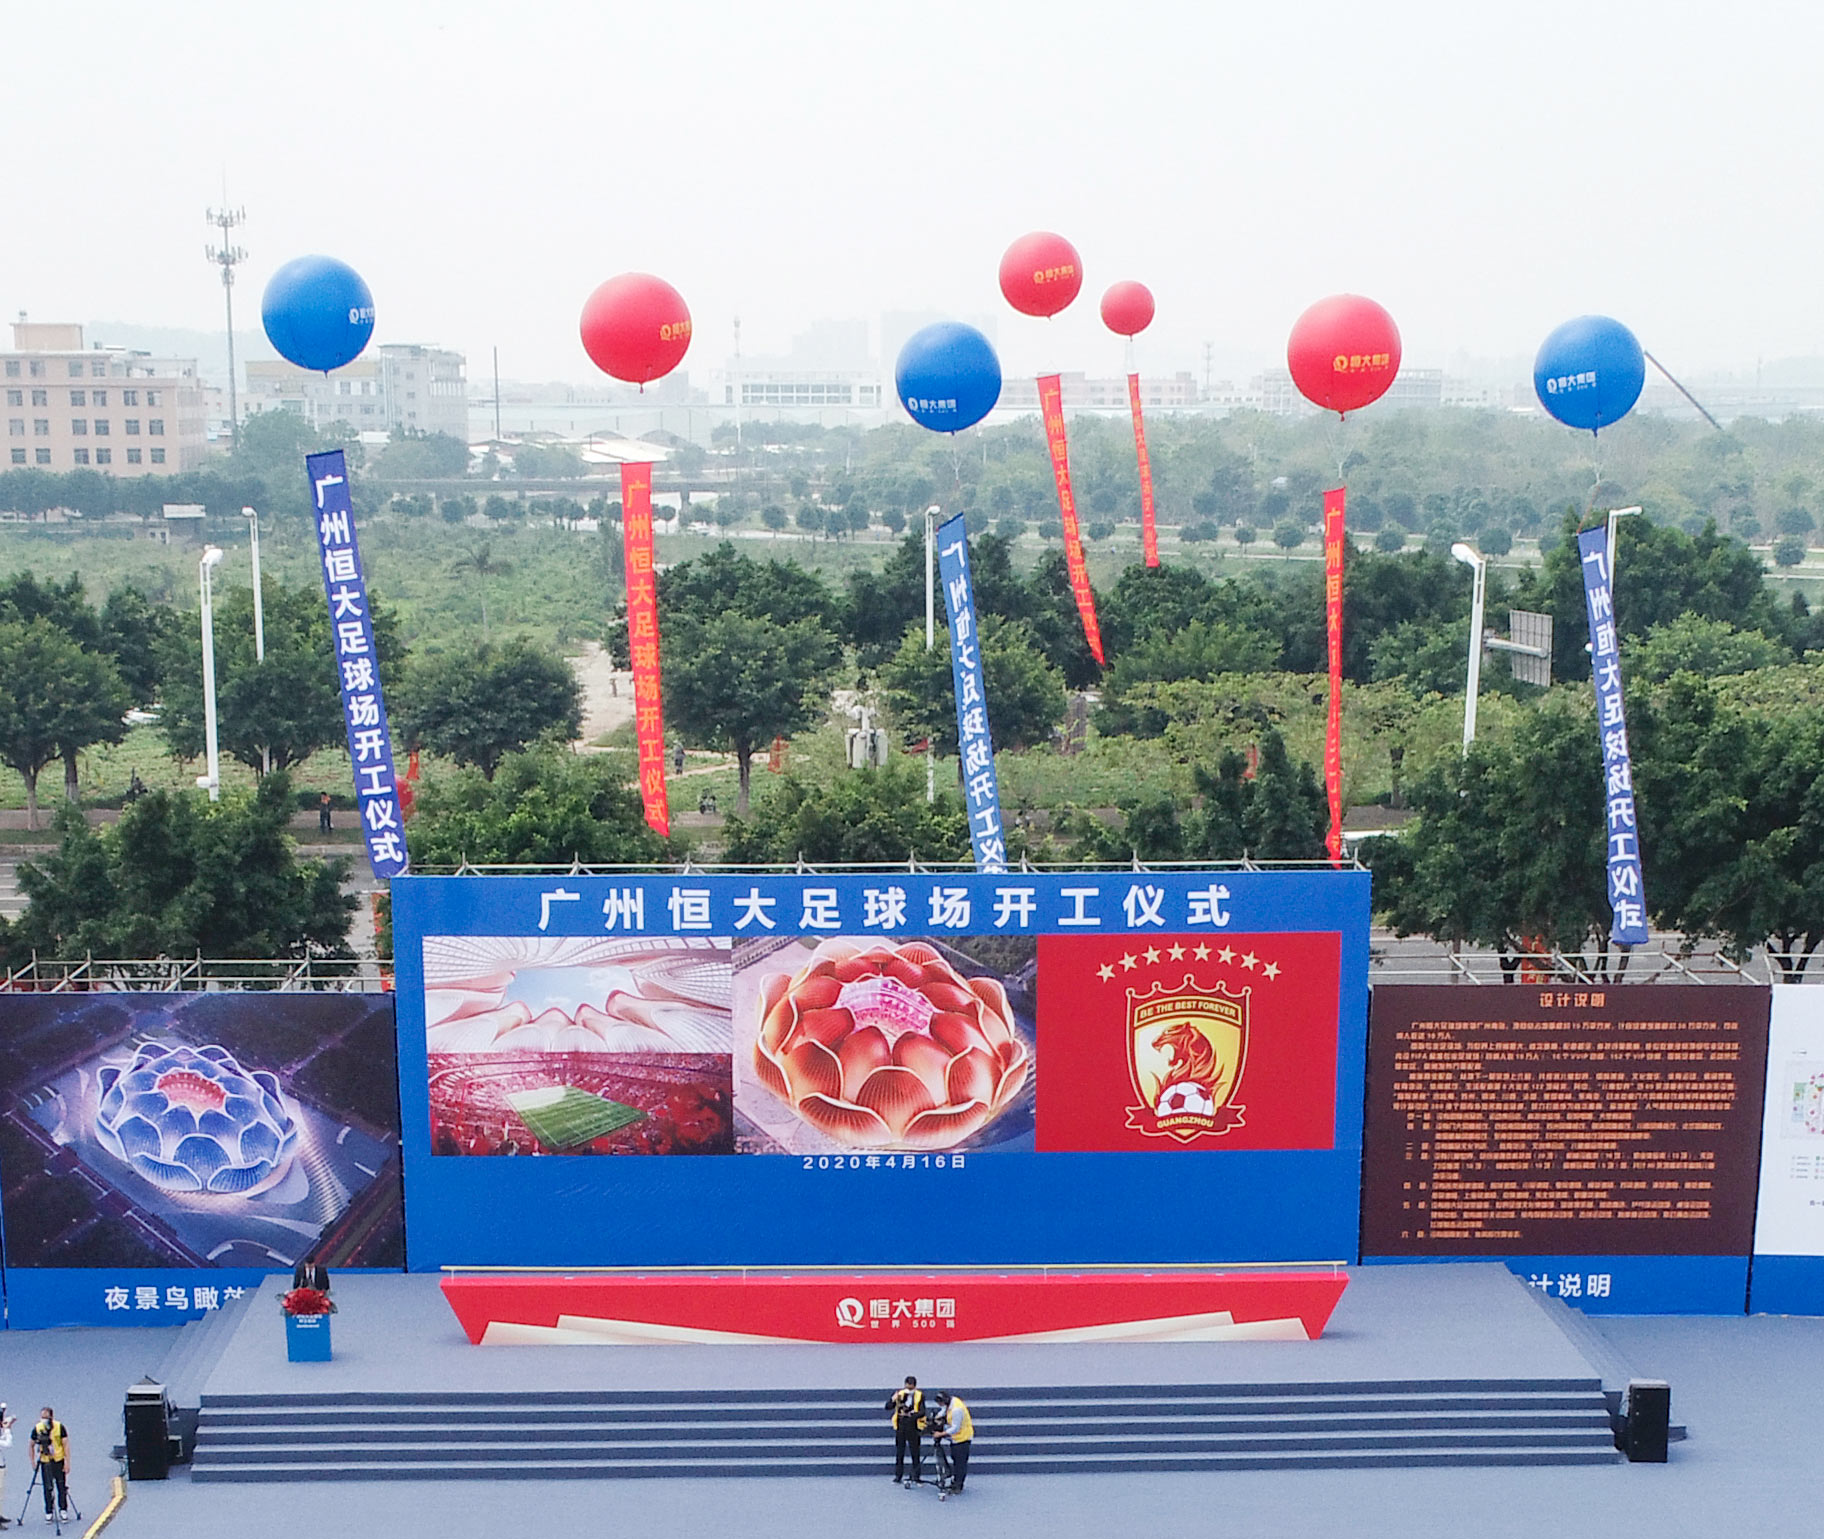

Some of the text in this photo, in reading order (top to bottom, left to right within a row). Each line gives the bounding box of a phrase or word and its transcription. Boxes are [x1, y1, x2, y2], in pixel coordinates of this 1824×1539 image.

[627, 480, 667, 825] 广州恒大足球场开工仪式
[315, 475, 404, 865] 广州恒大足球场开工仪式
[537, 884, 1233, 931] 广州恒大足球场开工仪式
[1539, 992, 1605, 1008] 设计说明
[1140, 1001, 1236, 1019] BE THE BEST FOREVER
[1156, 1115, 1214, 1129] GUANGZHOU
[803, 1154, 967, 1170] 2020年4月16日
[869, 1298, 956, 1319] 恒大集团
